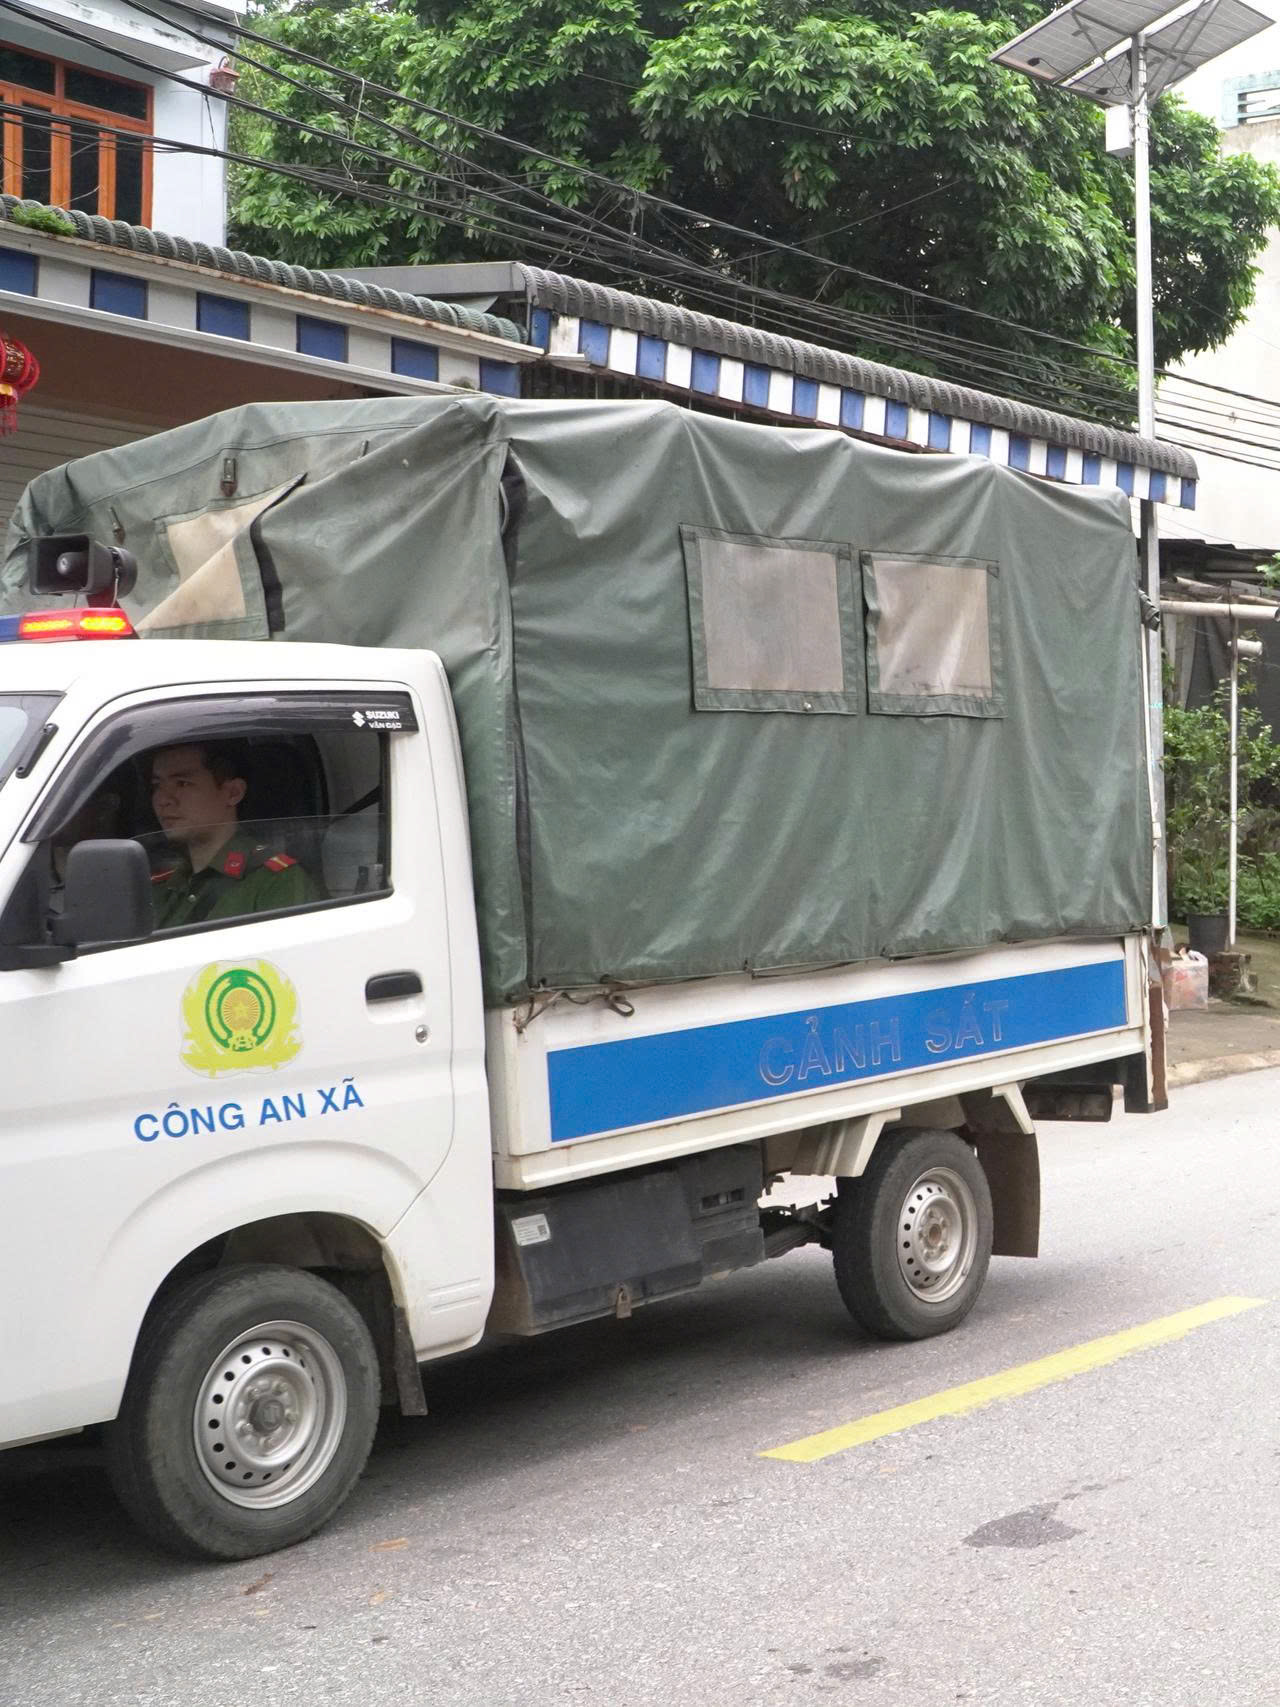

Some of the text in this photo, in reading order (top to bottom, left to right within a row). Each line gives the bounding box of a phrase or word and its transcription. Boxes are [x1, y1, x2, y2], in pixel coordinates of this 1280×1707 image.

[365, 711, 400, 719] SUZUKI
[759, 993, 1009, 1086] CẢNH SÁT
[134, 1077, 364, 1142] CÔNG AN XÃ
